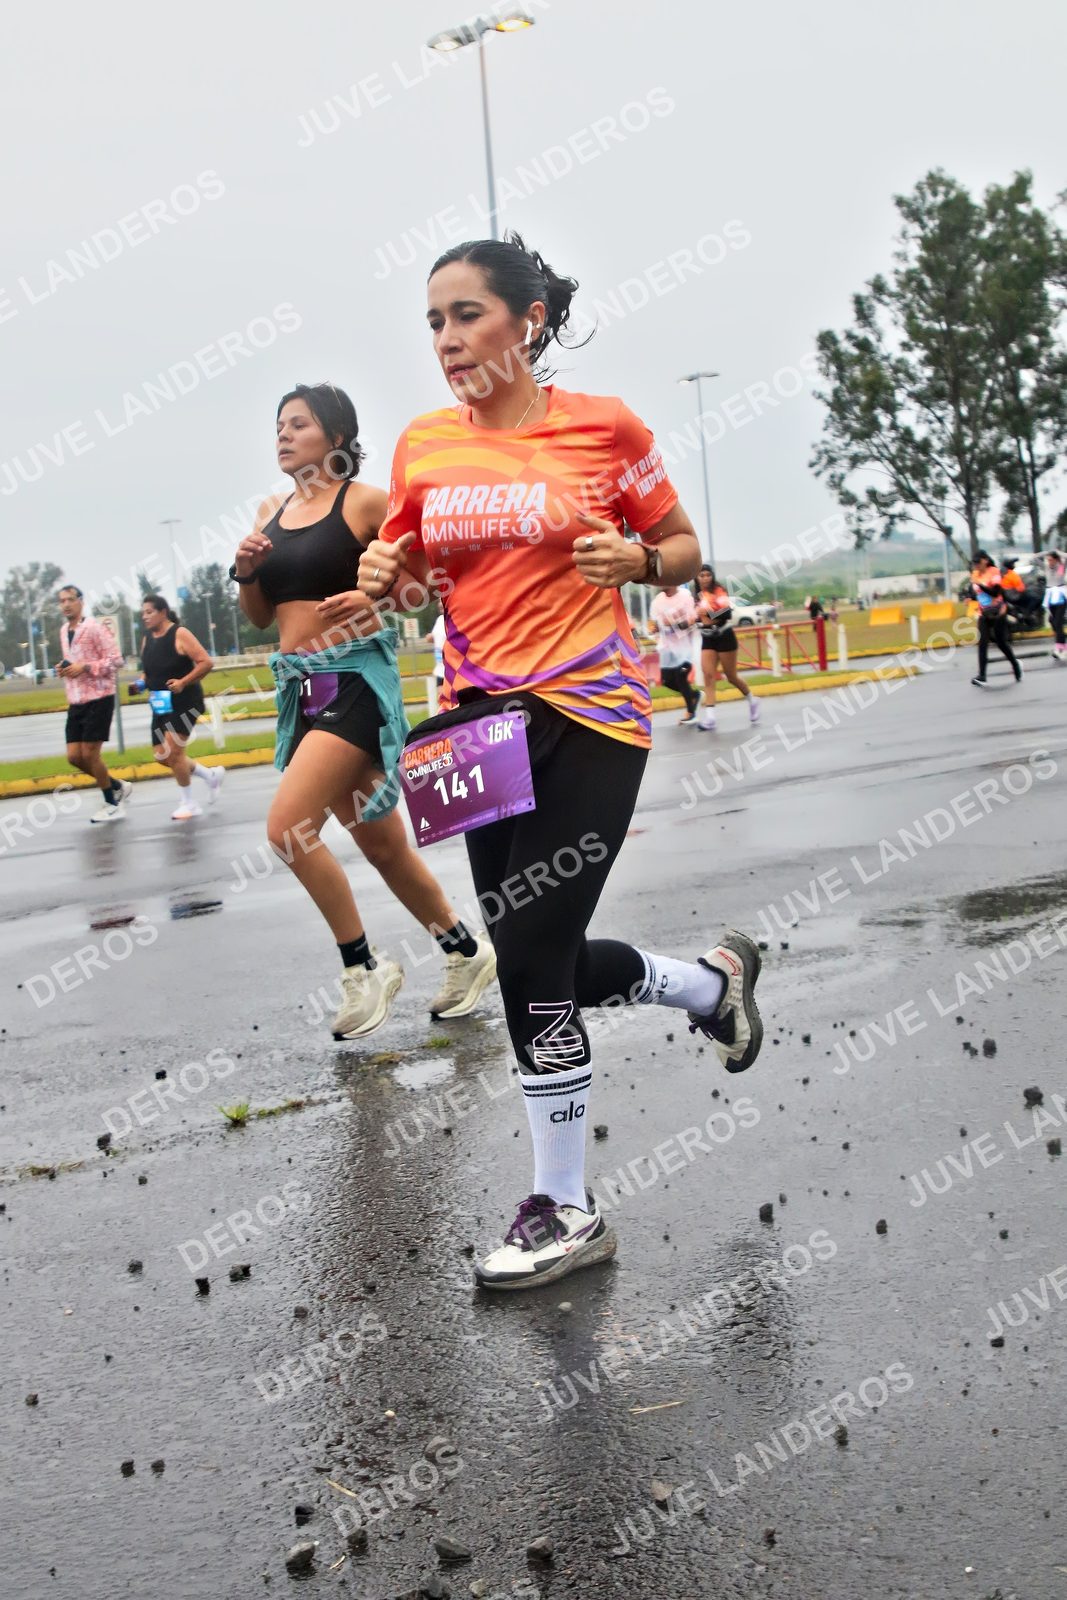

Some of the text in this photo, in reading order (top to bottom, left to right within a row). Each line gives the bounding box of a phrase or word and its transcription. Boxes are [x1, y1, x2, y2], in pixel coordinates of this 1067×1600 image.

[422, 482, 546, 520] CARRERA
[421, 518, 511, 544] OMNILIFE
[404, 737, 453, 769] CARRERA
[406, 757, 444, 780] OMNILIFE
[433, 764, 485, 806] 141
[549, 1100, 585, 1124] alo
